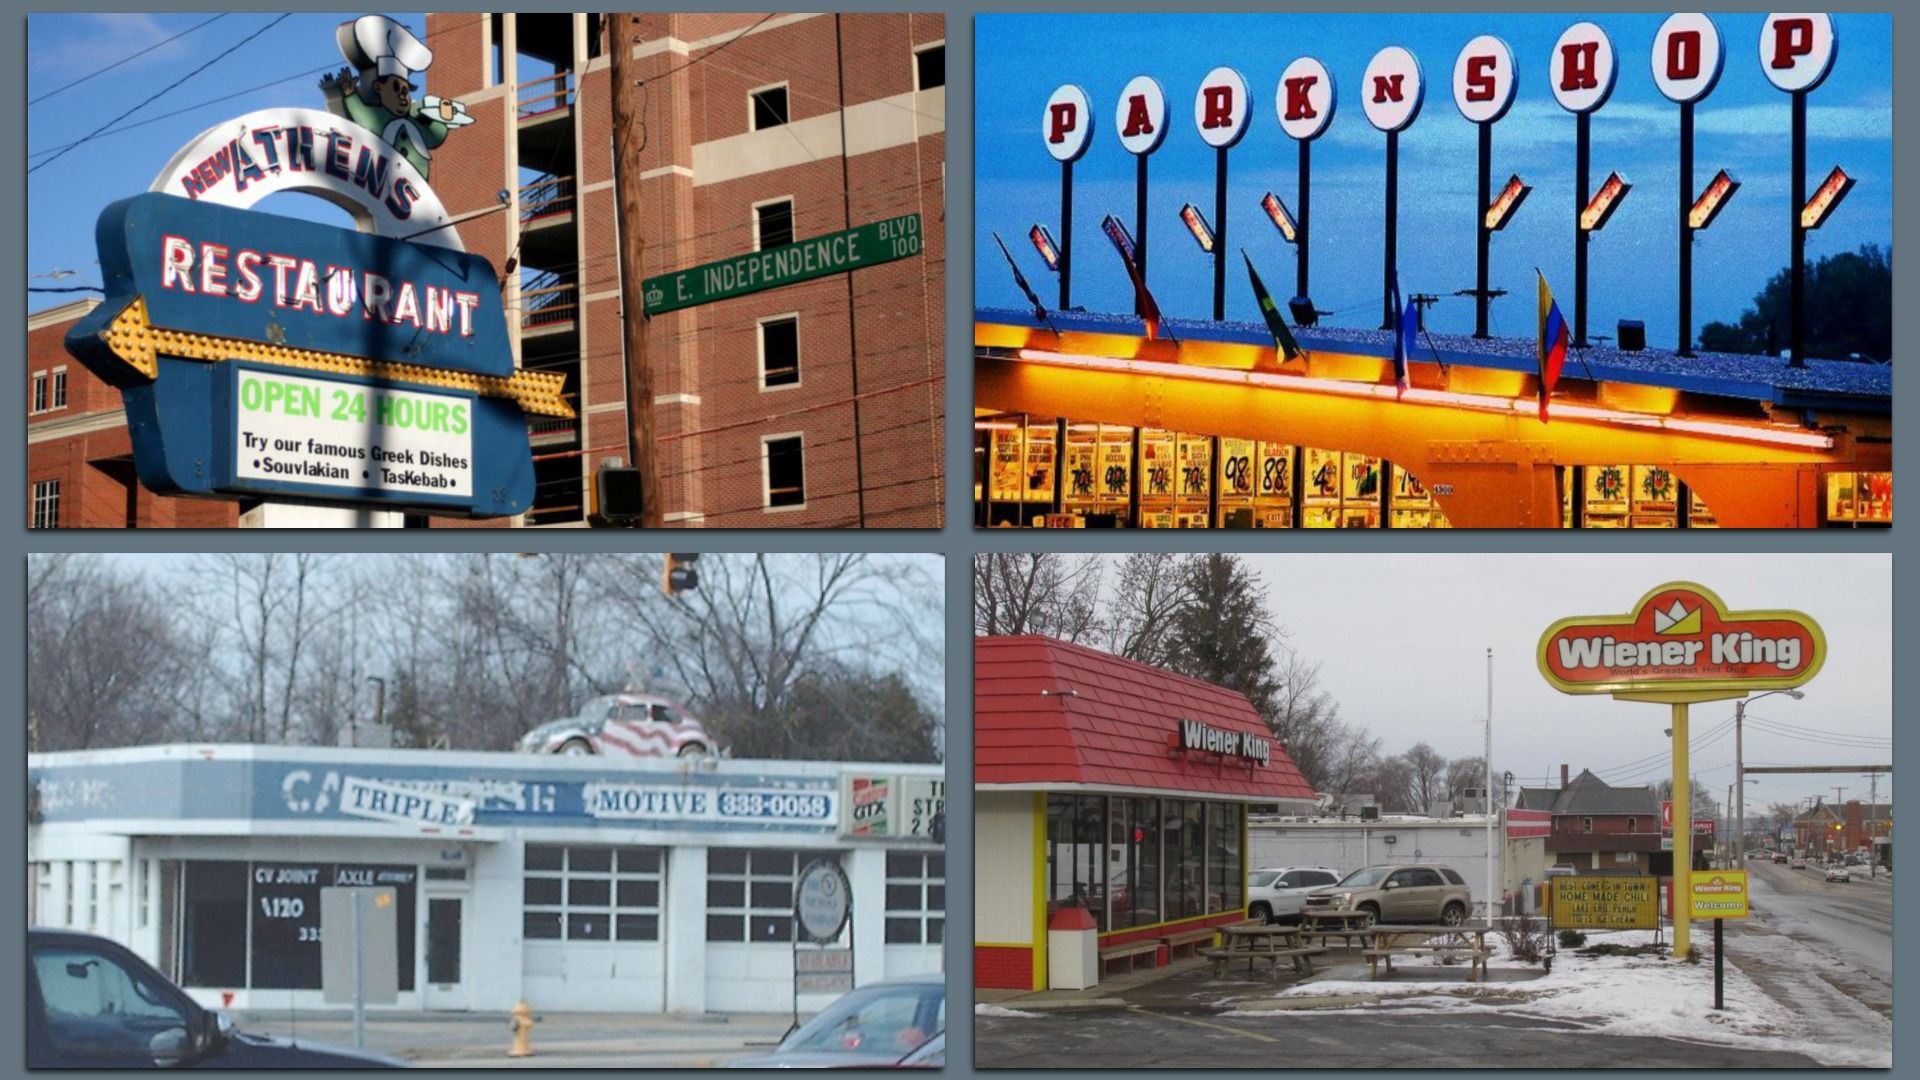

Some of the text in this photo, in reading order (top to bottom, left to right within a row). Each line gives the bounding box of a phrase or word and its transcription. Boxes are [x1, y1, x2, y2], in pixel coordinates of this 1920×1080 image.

[181, 125, 421, 220] NEW ATHENS
[676, 215, 918, 301] E. INDEPENDENCE BLVD
[892, 235, 918, 257] 100
[161, 233, 479, 338] RESTAURANT
[241, 378, 468, 435] OPEN 24 HOURS
[242, 431, 468, 469] Try our famous Greek Dishes
[1558, 631, 1801, 671] Wiener King
[1609, 665, 1748, 676] World's Greatest Hot Dog
[1184, 719, 1270, 768] Wiener King
[352, 785, 460, 824] TRIPLE
[722, 794, 827, 818] 333-0058
[256, 869, 274, 883] CV
[276, 869, 318, 884] JOINT
[338, 870, 375, 885] AXLE
[1560, 892, 1650, 902] HOME MADE CHILI
[1694, 900, 1743, 909] Welcome
